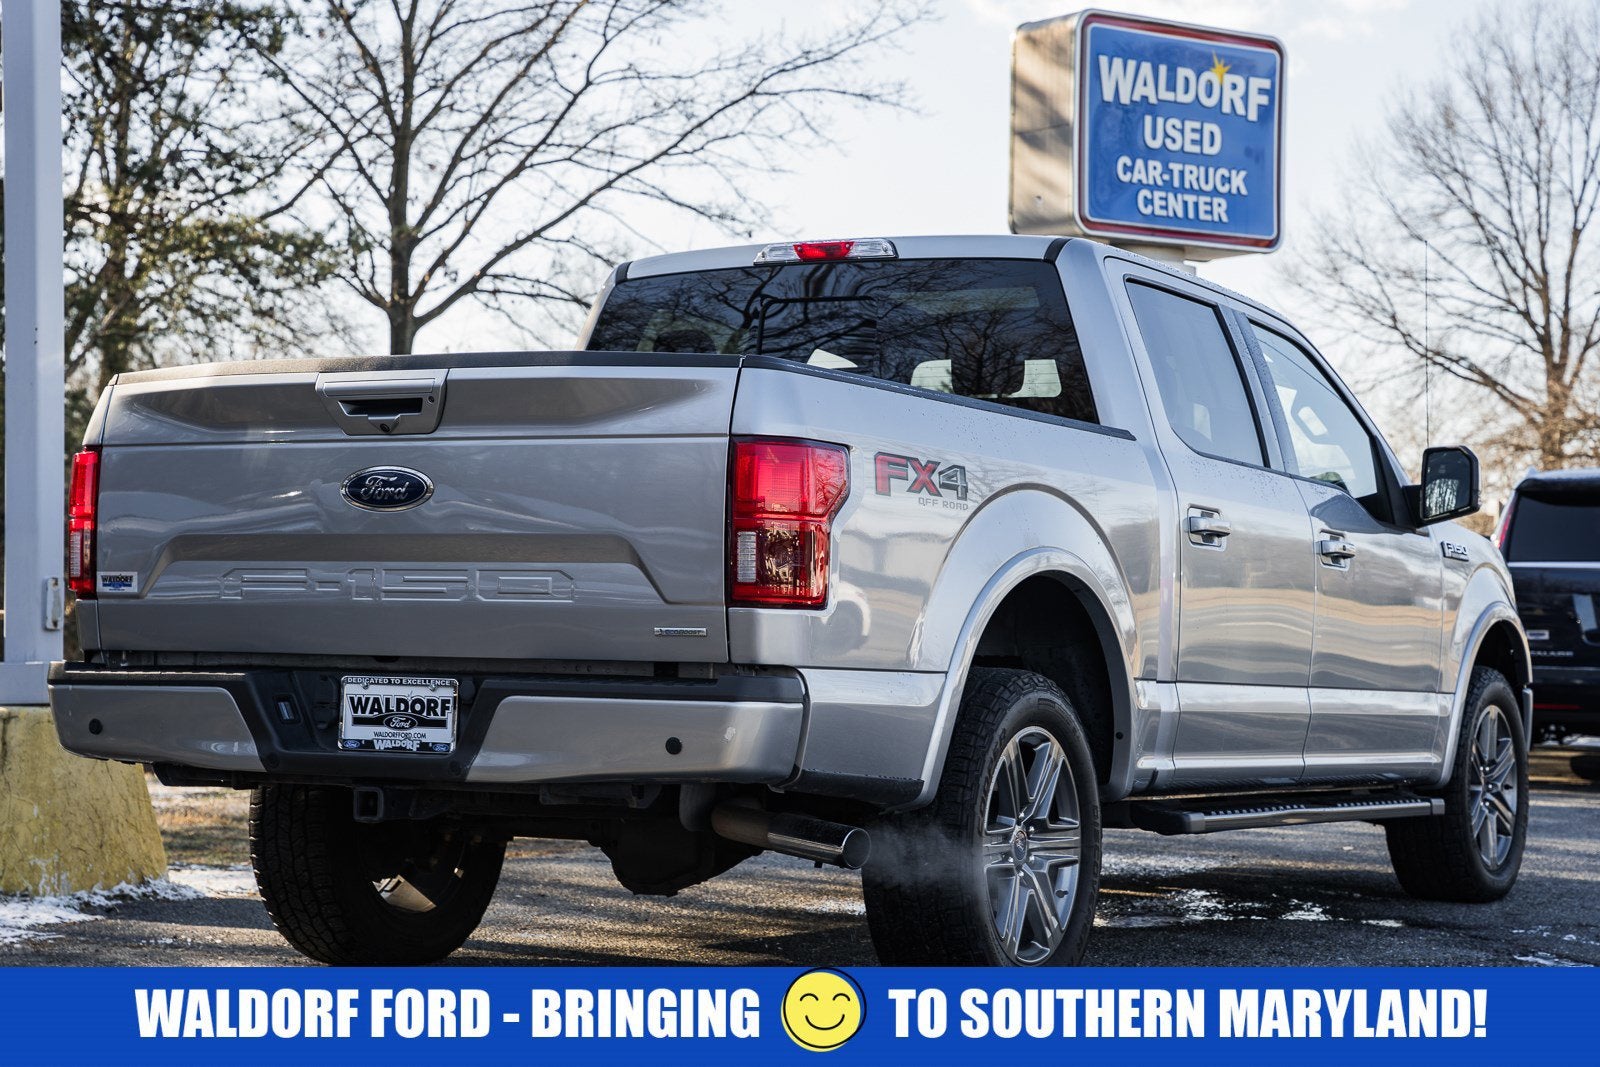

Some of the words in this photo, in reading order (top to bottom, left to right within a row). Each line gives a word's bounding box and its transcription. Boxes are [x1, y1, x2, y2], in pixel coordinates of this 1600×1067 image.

[1098, 54, 1272, 122] WALDORF
[1143, 115, 1222, 155] USED
[1116, 155, 1248, 195] CAR-TRUCK
[1137, 188, 1229, 223] CENTER
[360, 475, 410, 500] Ford
[874, 451, 968, 501] FX4
[918, 497, 939, 507] OFF
[943, 500, 969, 511] ROAD
[220, 568, 575, 602] F-150
[347, 677, 389, 685] DEDICATED
[402, 678, 451, 687] EXCELLENCE
[347, 694, 452, 718] WALDORF
[373, 731, 427, 740] WALDORFFORD.COM
[389, 717, 411, 729] Ford
[373, 740, 420, 751] WALDORF
